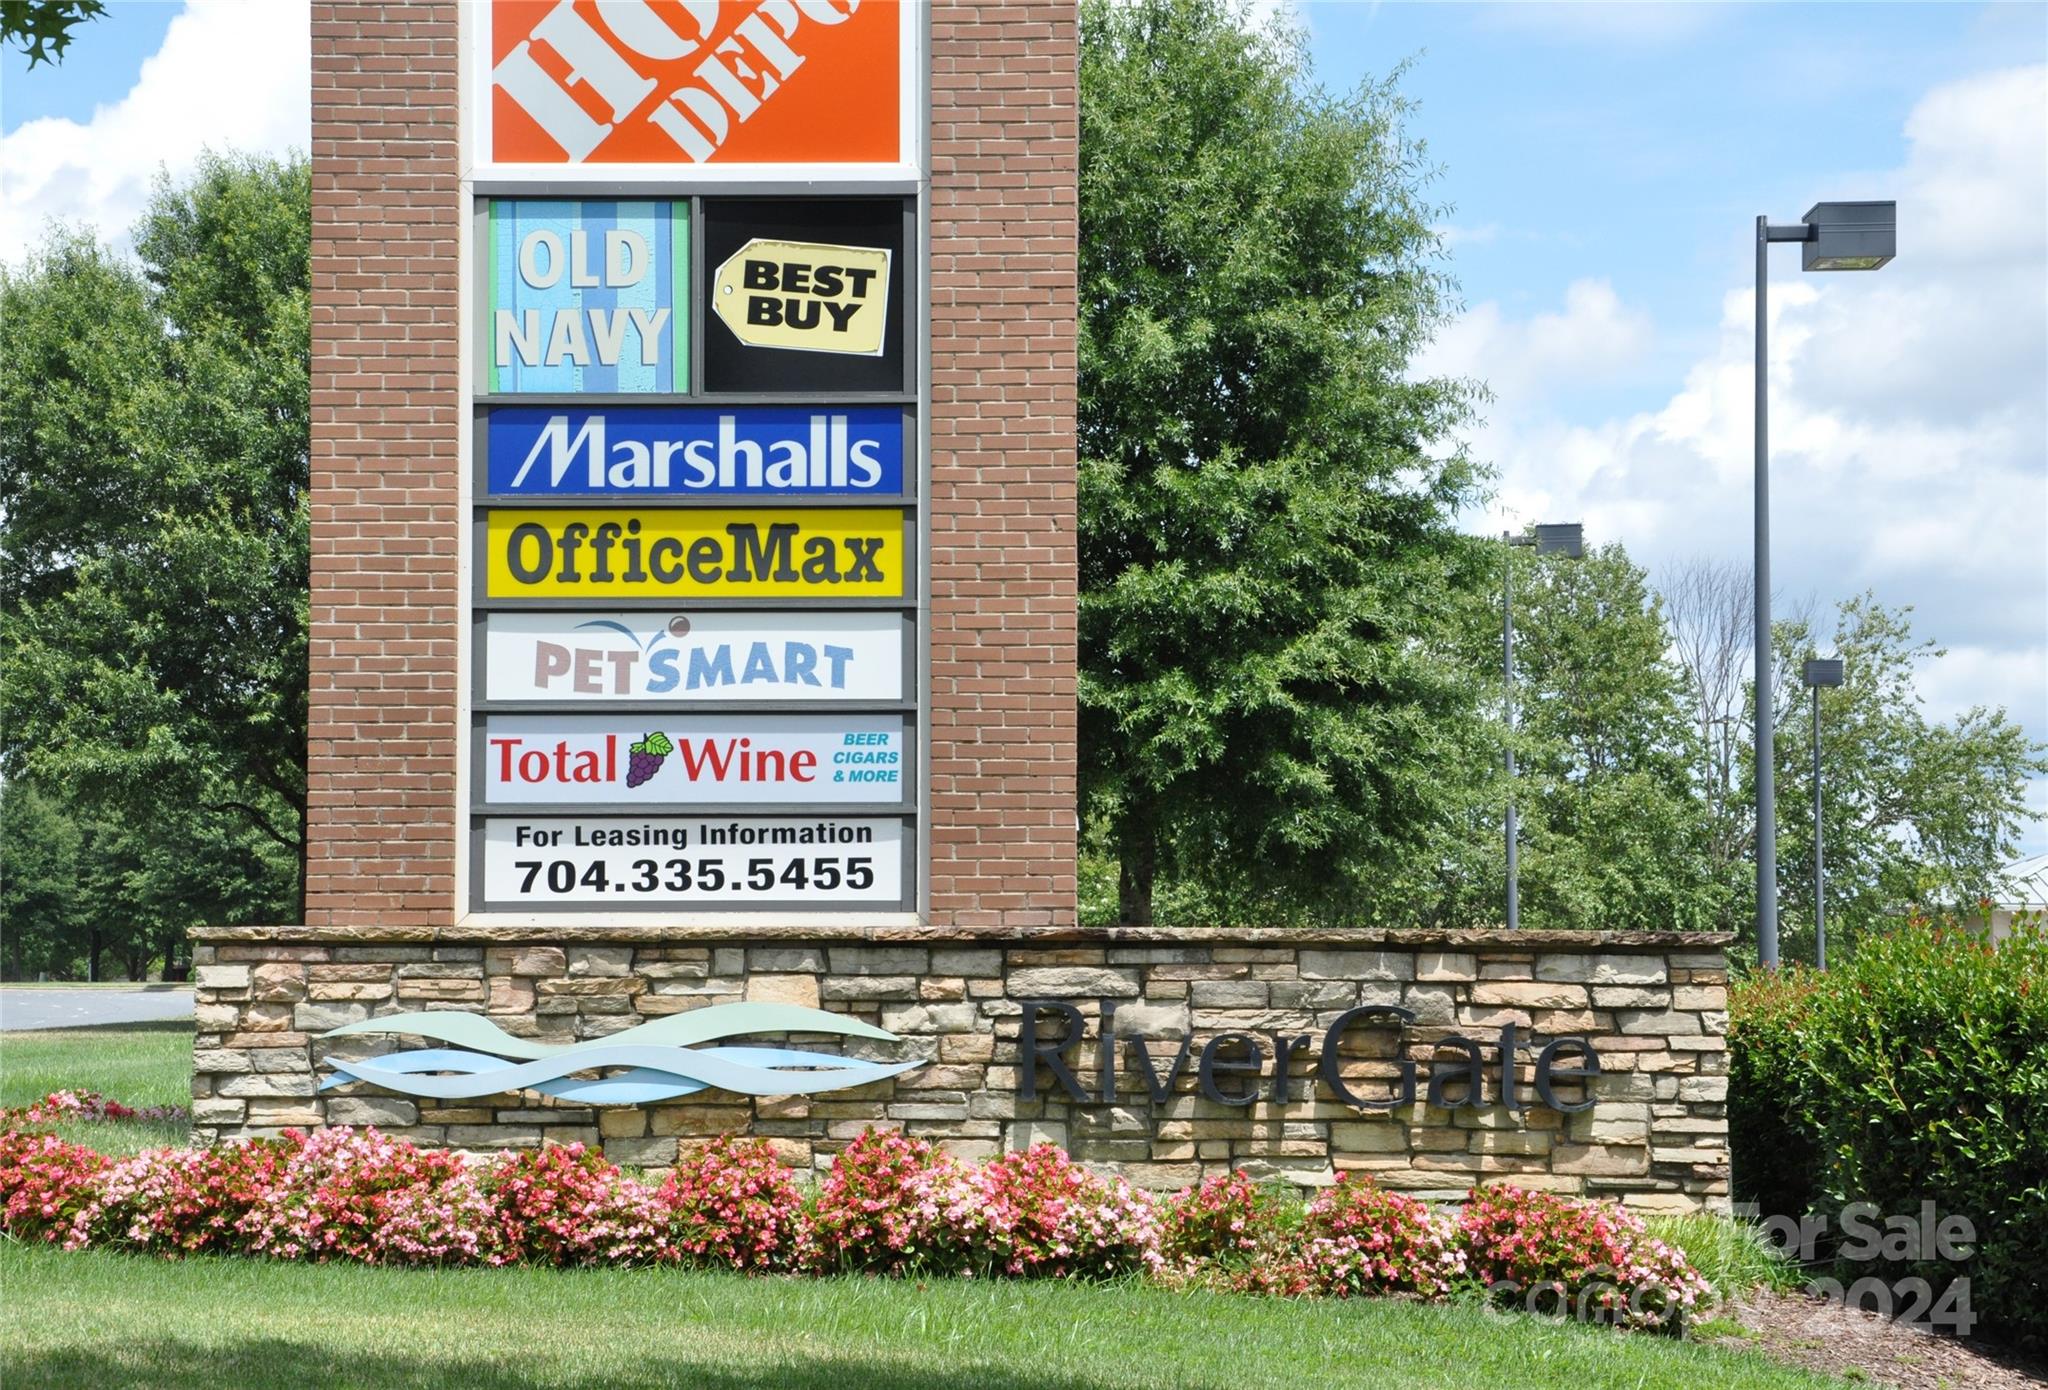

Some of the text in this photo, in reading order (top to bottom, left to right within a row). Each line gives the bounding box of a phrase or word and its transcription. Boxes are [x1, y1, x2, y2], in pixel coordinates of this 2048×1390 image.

[518, 230, 649, 290] OLD
[742, 259, 877, 299] BEST
[747, 295, 863, 333] BUY
[494, 308, 672, 368] NAVY
[510, 415, 883, 488] Marshalls
[507, 518, 885, 584] OfficeMax
[490, 735, 818, 783] Total Wine
[833, 751, 899, 764] CIGARS
[843, 733, 889, 746] BEER
[833, 769, 899, 783] & MORE
[515, 823, 873, 850] For Leasing Information
[515, 857, 875, 893] 704.335.5455
[1020, 1000, 1602, 1113] RiverGate
